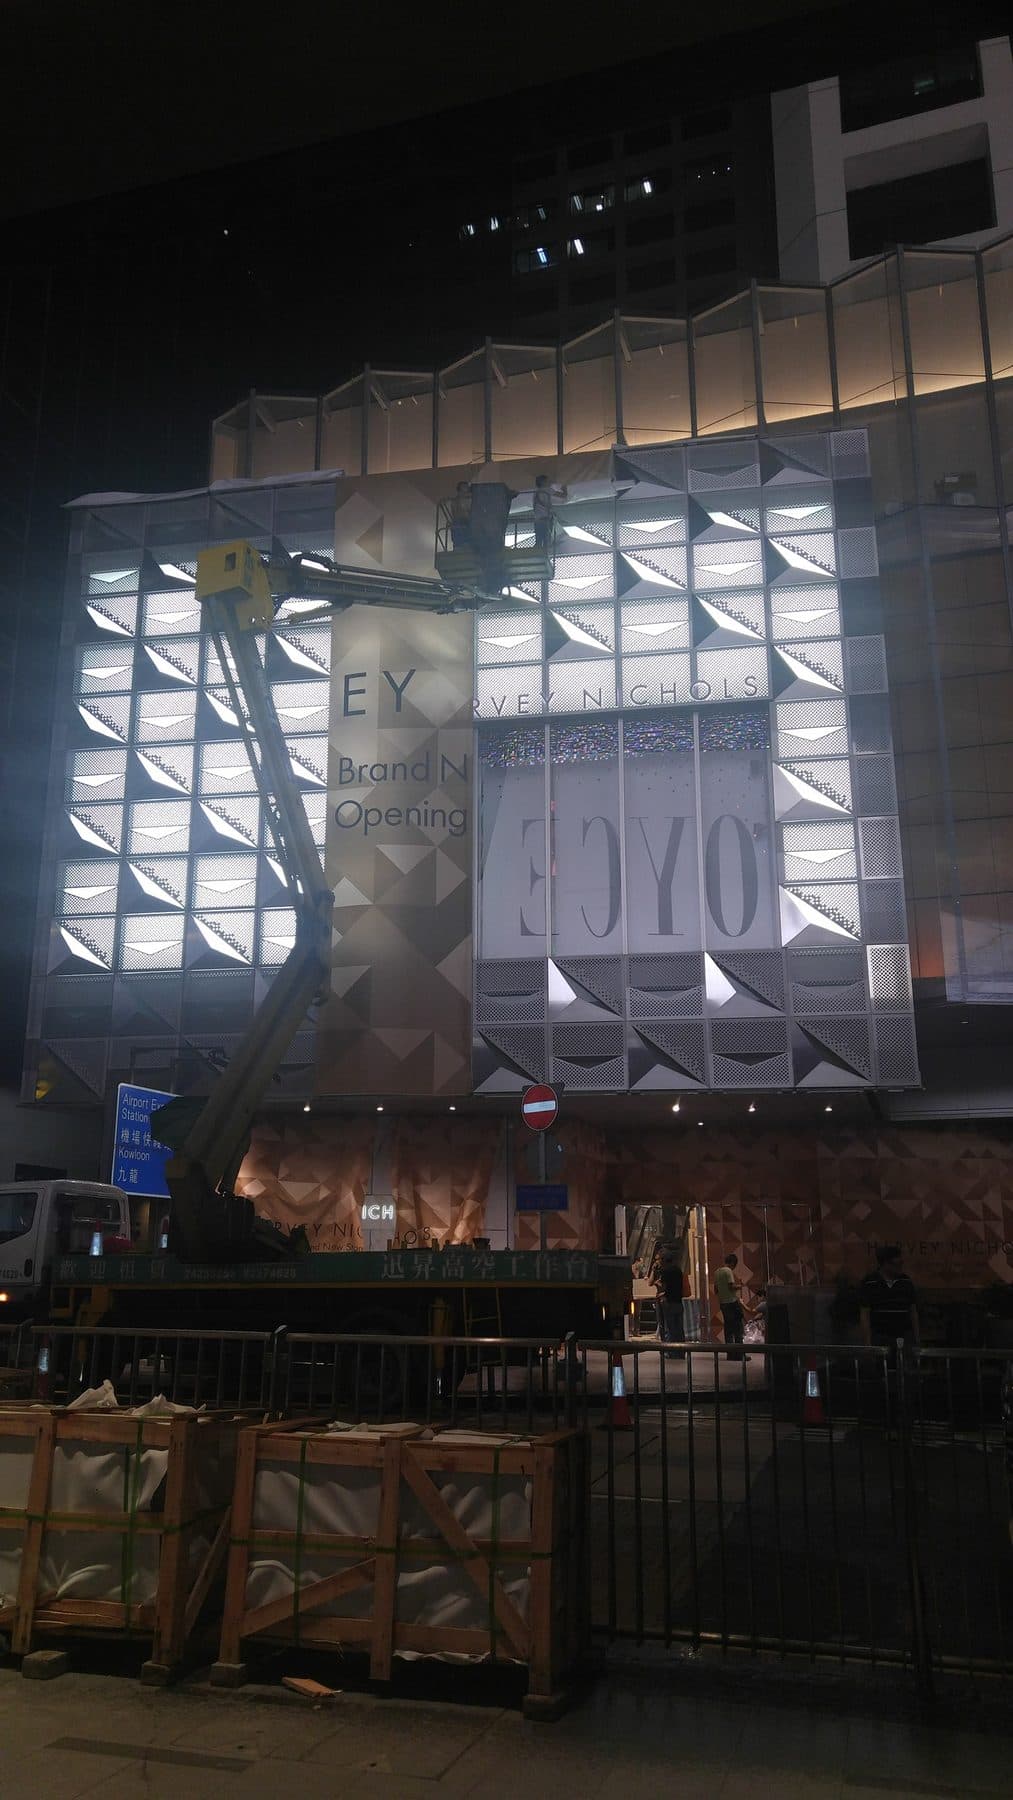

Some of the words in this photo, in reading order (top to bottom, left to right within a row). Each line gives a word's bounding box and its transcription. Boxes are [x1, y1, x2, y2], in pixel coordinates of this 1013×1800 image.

[343, 669, 416, 717] EY
[583, 676, 758, 709] NICHOLS
[339, 752, 429, 785] Brand
[441, 753, 468, 784] N
[335, 800, 467, 837] Opening
[122, 1093, 149, 1109] Airport
[121, 1107, 149, 1123] Station
[119, 1146, 150, 1161] Kowloon
[117, 1166, 139, 1184] 九龍
